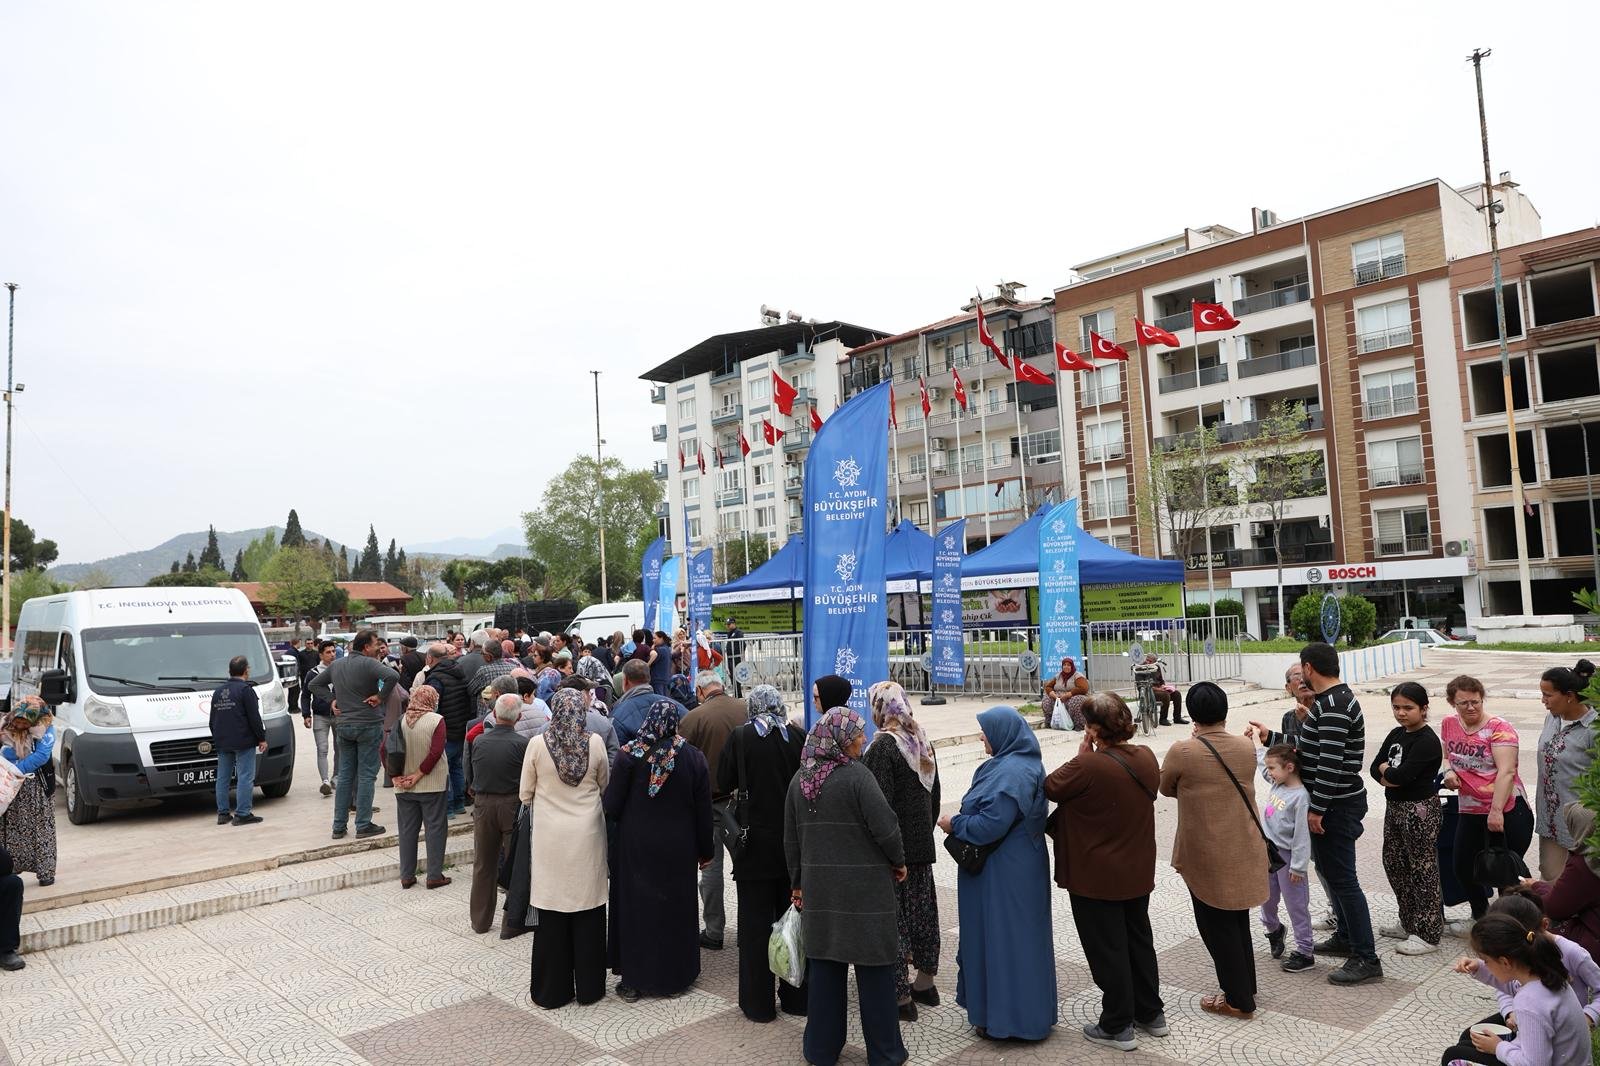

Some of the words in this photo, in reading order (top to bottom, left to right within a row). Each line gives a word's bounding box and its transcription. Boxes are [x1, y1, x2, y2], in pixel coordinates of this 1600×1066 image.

[844, 490, 867, 498] AYDIN
[826, 511, 865, 520] BELEDİYEİ
[1200, 553, 1224, 561] AVKAT
[1328, 566, 1376, 579] BOSCH
[974, 577, 1013, 586] BÜYÜKŞEHİR
[846, 584, 863, 592] ADIN
[181, 599, 233, 607] BELEDİYESİ
[962, 613, 979, 621] ahip
[848, 678, 863, 686] DIN
[184, 771, 195, 782] 09
[199, 769, 215, 780] APE
[1270, 794, 1286, 811] OVE
